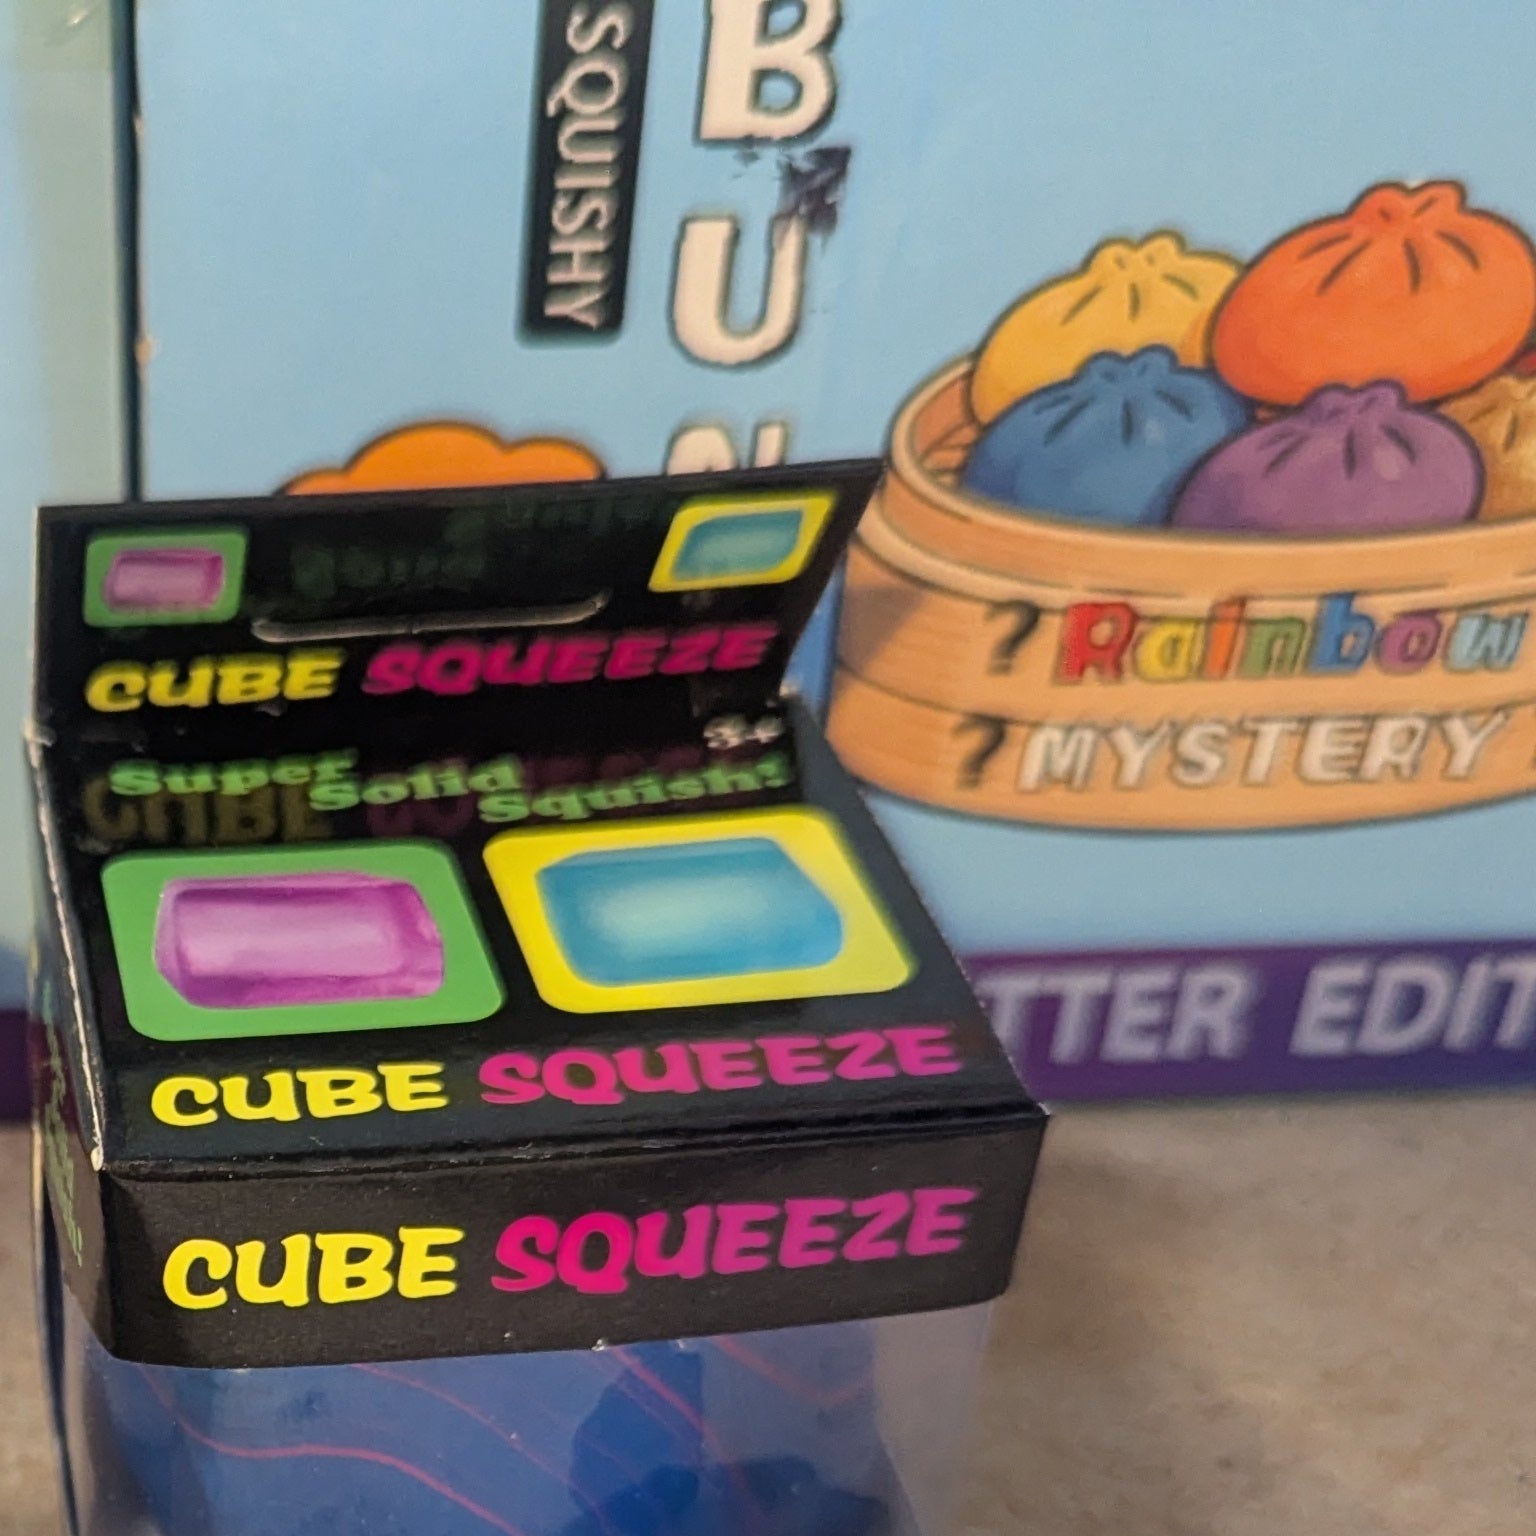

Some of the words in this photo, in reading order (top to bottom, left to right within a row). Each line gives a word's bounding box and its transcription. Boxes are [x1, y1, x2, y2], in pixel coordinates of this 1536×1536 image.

[543, 4, 634, 331] SQUISHY
[84, 647, 346, 712] CUBE
[361, 621, 781, 697] SQUEEZE
[1054, 591, 1530, 685] Rainbow
[109, 749, 358, 796] Super
[309, 753, 524, 811] Solid
[1017, 710, 1509, 793] MYSTERY
[150, 1060, 449, 1128] CUBE
[479, 1026, 962, 1107] SQUEEZE
[162, 1227, 464, 1311] CUBE
[489, 1188, 976, 1295] SQUEEZE
